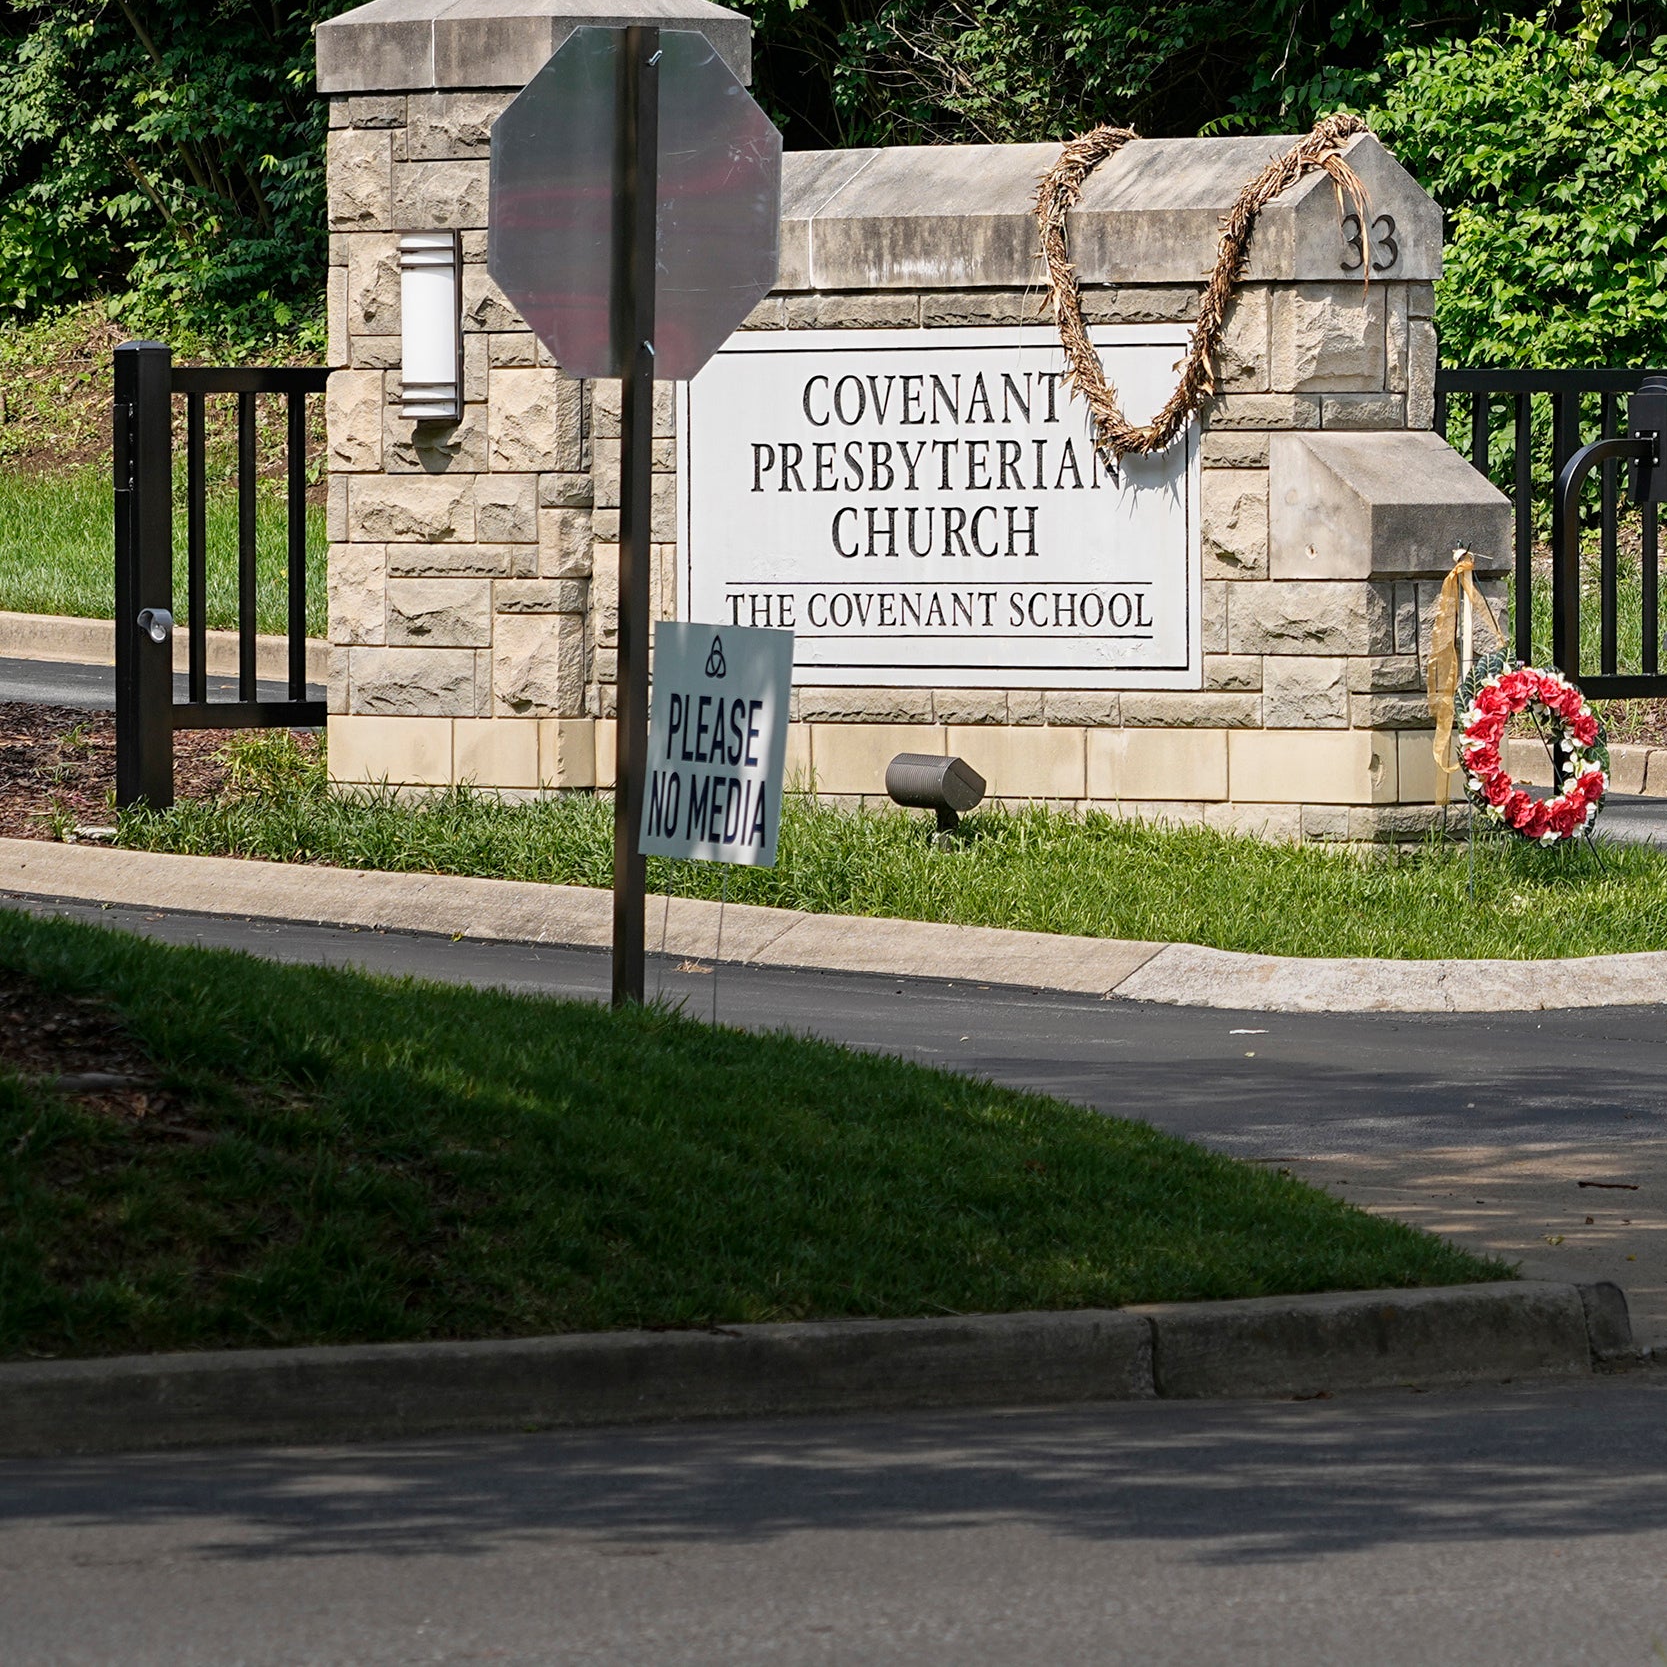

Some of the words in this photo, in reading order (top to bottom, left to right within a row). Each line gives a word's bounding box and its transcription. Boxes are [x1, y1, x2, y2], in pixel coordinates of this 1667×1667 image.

[1340, 213, 1399, 271] 33
[801, 369, 1065, 427] COVENANT
[749, 436, 1121, 493] PRESBYTERIAN
[830, 505, 1041, 560] CHURCH
[725, 592, 797, 628] THE
[806, 590, 998, 629] COVENANT
[1008, 590, 1154, 629] SCHOOL
[665, 691, 764, 768] PLEASE
[646, 770, 682, 840] NO
[685, 773, 767, 849] MEDIA
